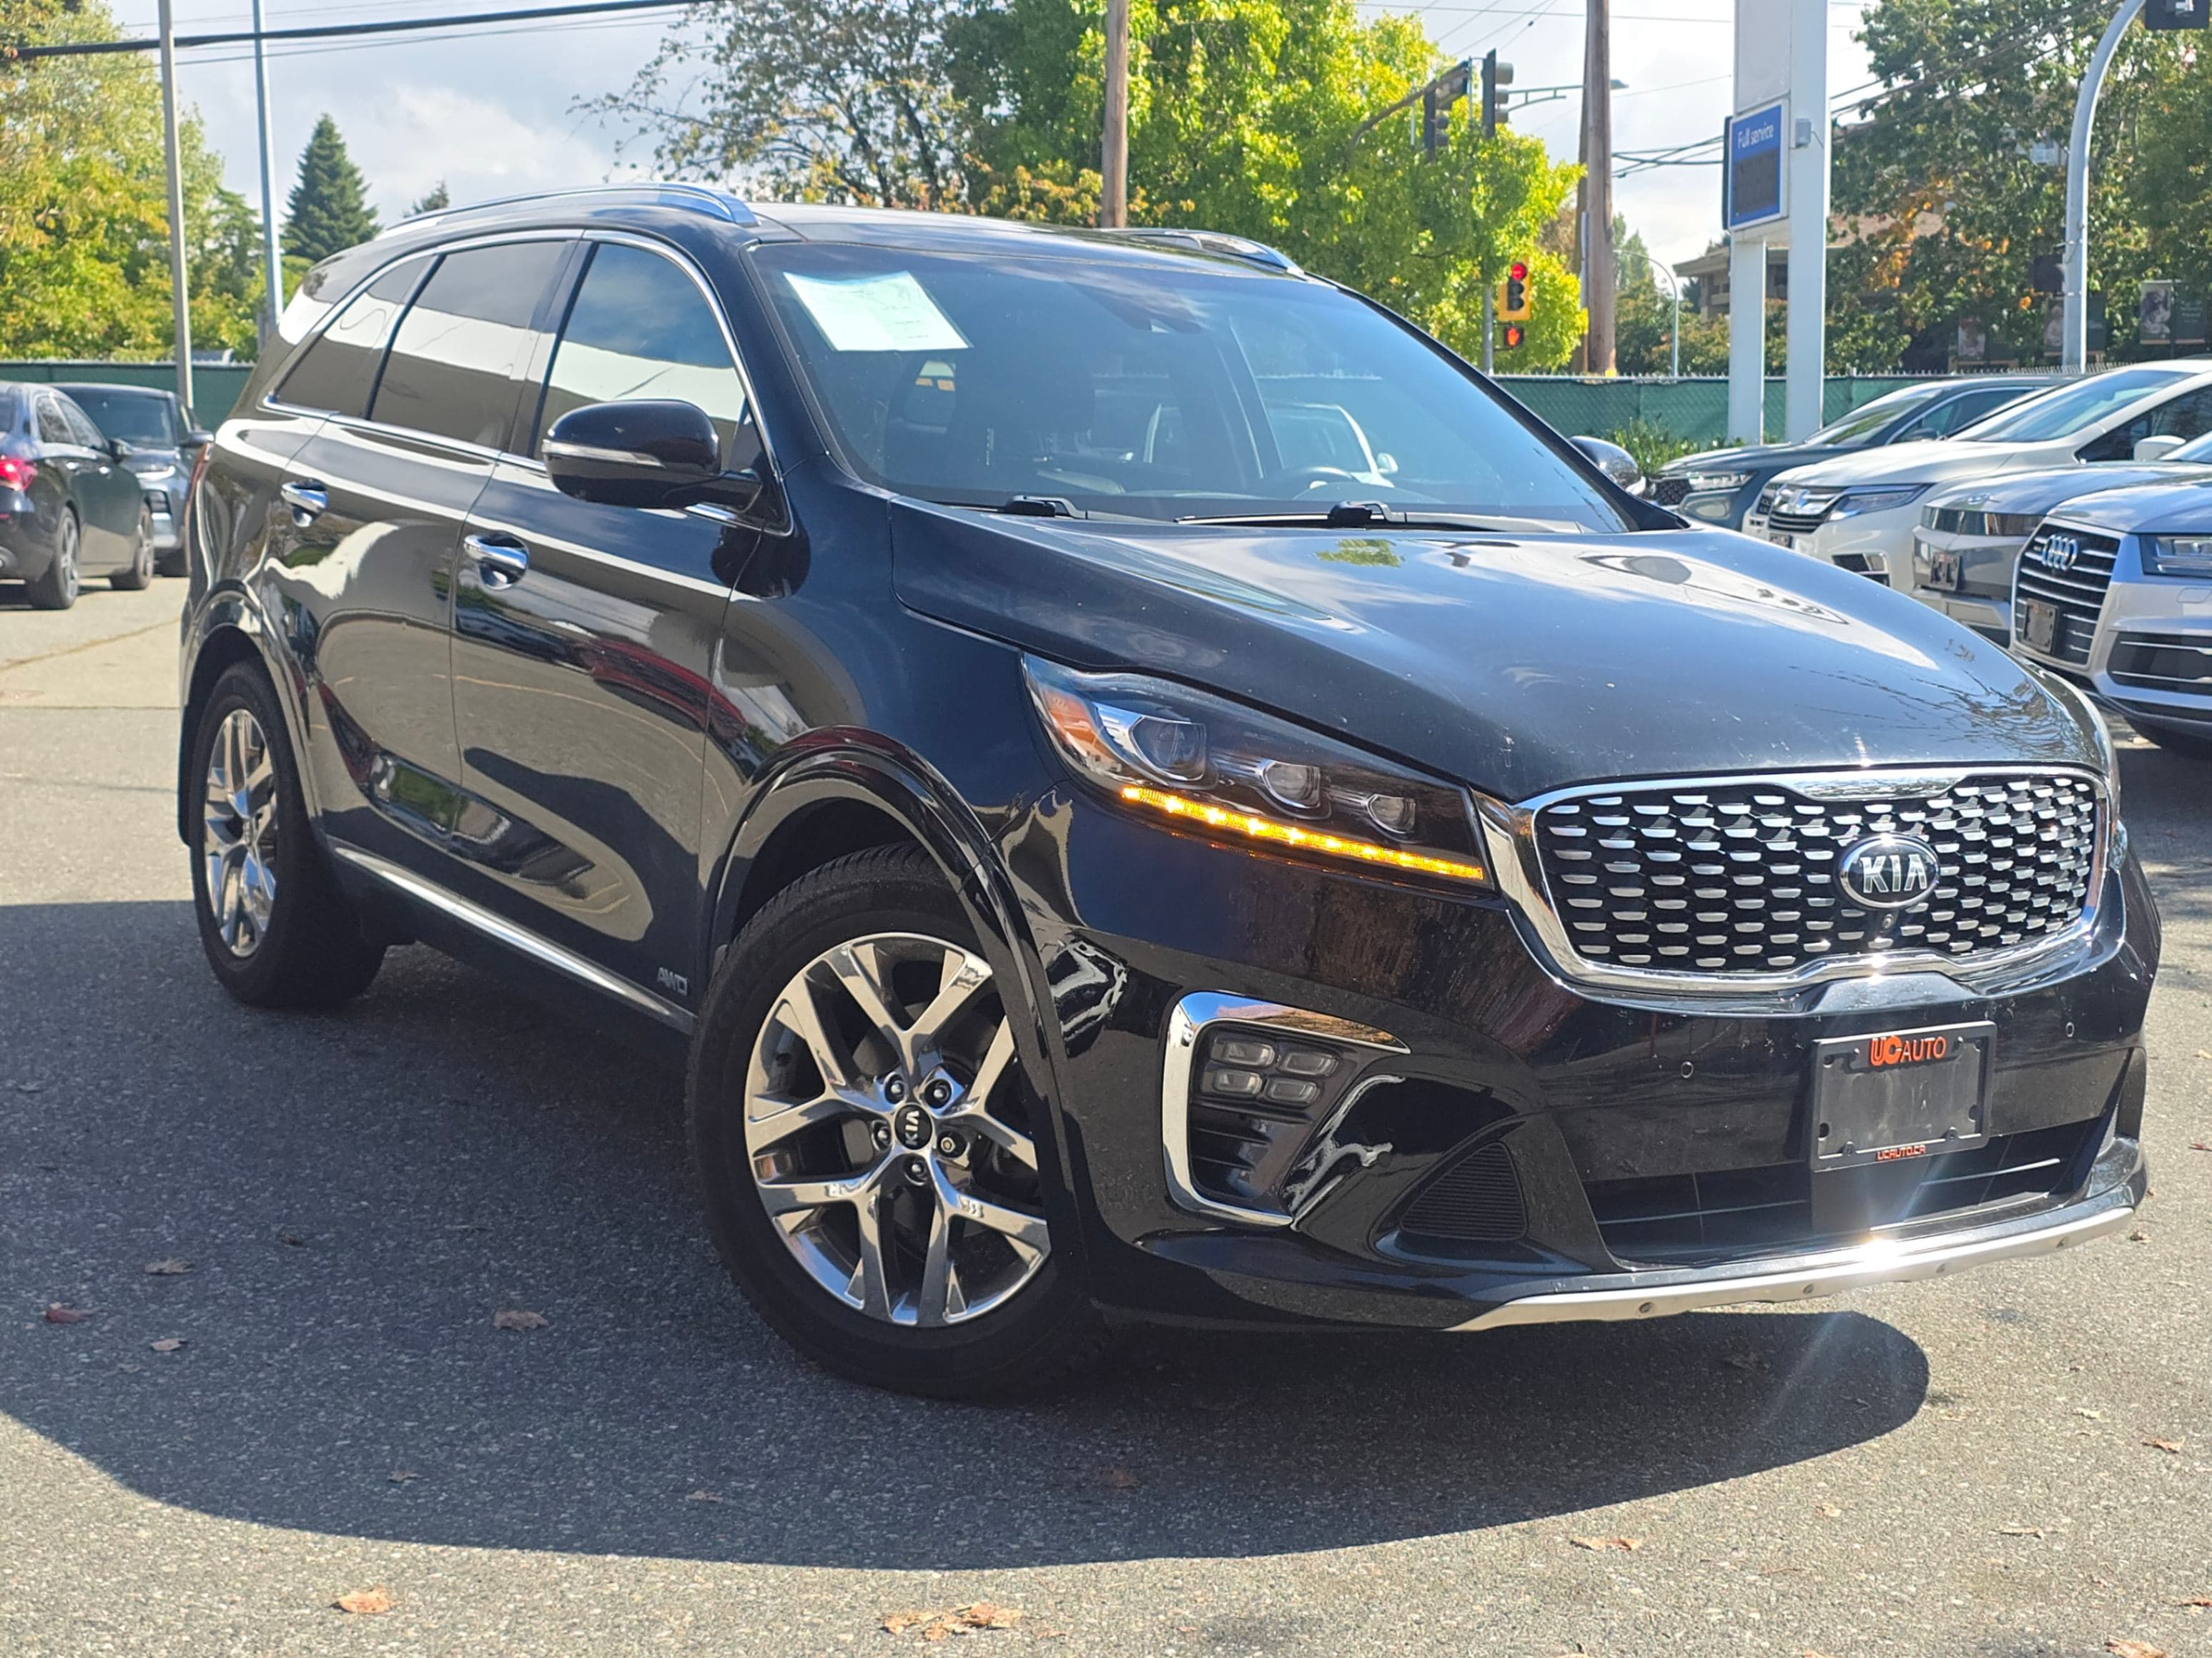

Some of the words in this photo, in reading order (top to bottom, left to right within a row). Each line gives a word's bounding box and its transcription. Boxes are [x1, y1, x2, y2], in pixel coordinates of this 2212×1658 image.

[1738, 128, 1750, 149] Full
[1751, 122, 1774, 145] service
[1860, 854, 1927, 893] KIA
[658, 967, 688, 996] AWD
[905, 1110, 919, 1145] KIA
